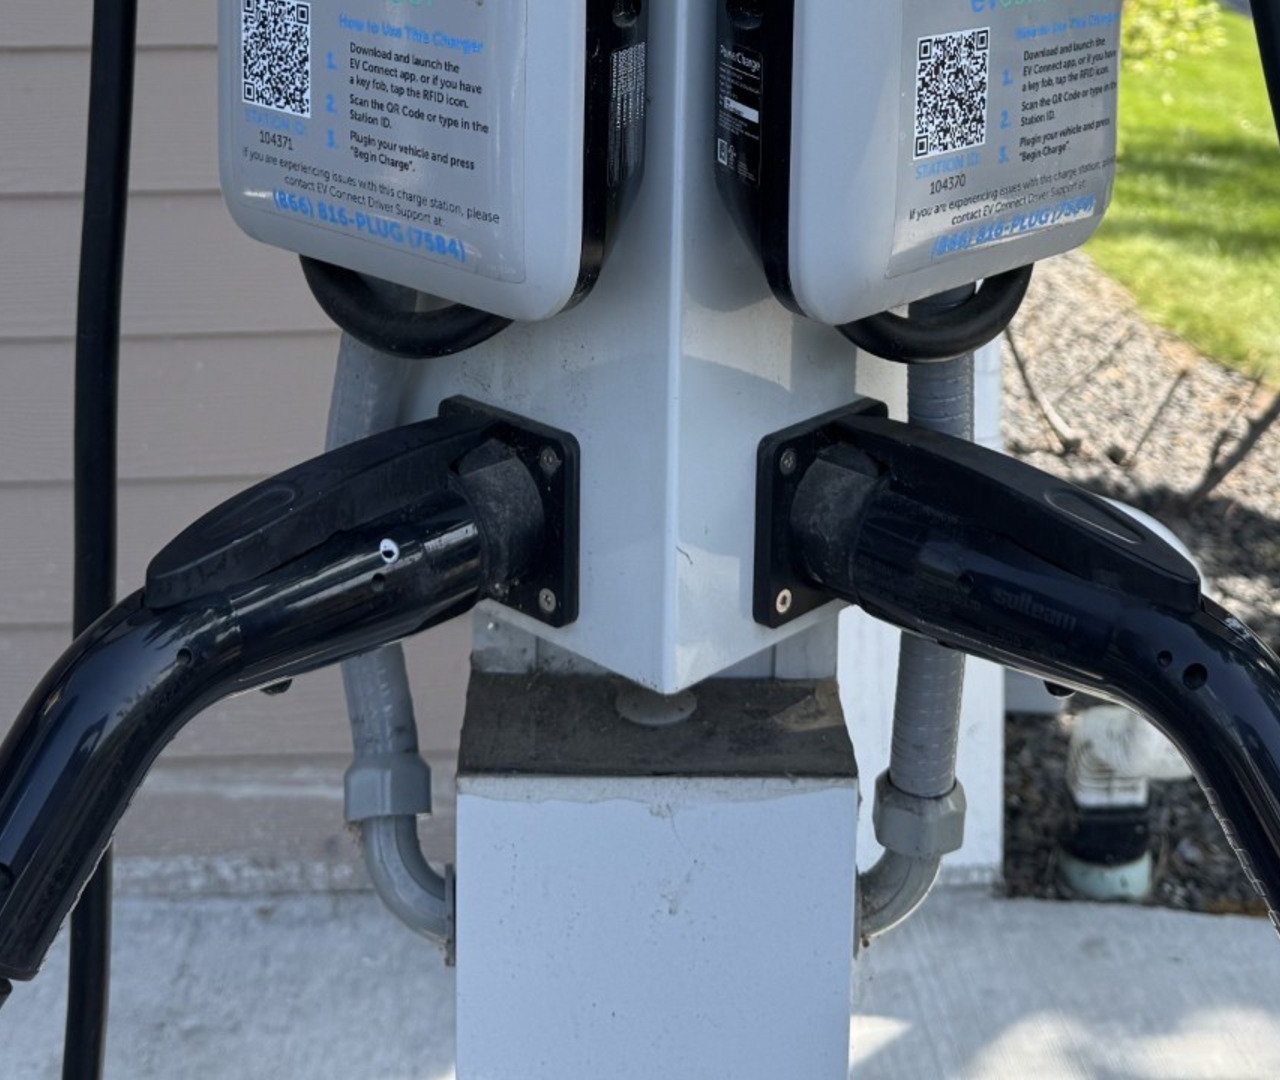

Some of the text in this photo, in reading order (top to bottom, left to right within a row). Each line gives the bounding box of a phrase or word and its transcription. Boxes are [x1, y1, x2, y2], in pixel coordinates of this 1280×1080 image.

[349, 41, 460, 74] Download and launch the
[1023, 36, 1106, 61] Download and launch the
[349, 57, 361, 70] EV
[362, 60, 398, 78] Connect
[420, 73, 431, 84] or
[439, 77, 458, 92] you
[459, 80, 483, 95] have
[1023, 65, 1032, 77] EV
[1033, 60, 1062, 75] Connect
[1091, 52, 1104, 65] you
[349, 77, 355, 86] a
[356, 75, 371, 92] key
[390, 84, 405, 97] tap
[406, 86, 421, 99] the
[422, 89, 445, 104] RFID
[1028, 80, 1039, 93] key
[1055, 75, 1067, 86] tap
[1067, 72, 1078, 82] the
[1021, 100, 1038, 112] Scan
[1039, 97, 1051, 108] the
[1052, 92, 1062, 105] QR
[1063, 90, 1081, 102] Code
[1089, 85, 1103, 98] type
[349, 93, 489, 134] Scan the QR Code or type in the
[349, 109, 378, 127] Station
[1020, 113, 1045, 127] Station
[260, 129, 293, 151] 104371
[1020, 134, 1041, 148] Plugin
[1041, 131, 1058, 145] your
[1059, 123, 1081, 138] vehicle
[1082, 120, 1094, 132] and
[349, 130, 476, 172] Plugin your vehicle and press
[250, 150, 265, 163] you
[265, 153, 278, 166] are
[279, 158, 331, 182] experiencing
[358, 176, 378, 193] with
[379, 182, 395, 199] this
[396, 189, 429, 209] charge
[466, 204, 501, 225] please
[929, 173, 966, 195] 104370
[284, 176, 317, 193] contact
[317, 181, 328, 195] EV
[329, 185, 367, 206] Connect
[394, 202, 432, 225] Support
[915, 207, 933, 222] you
[933, 202, 947, 215] are
[948, 188, 999, 211] experiencing
[951, 208, 981, 226] contact
[982, 204, 994, 217] EV
[995, 196, 1026, 214] Connect
